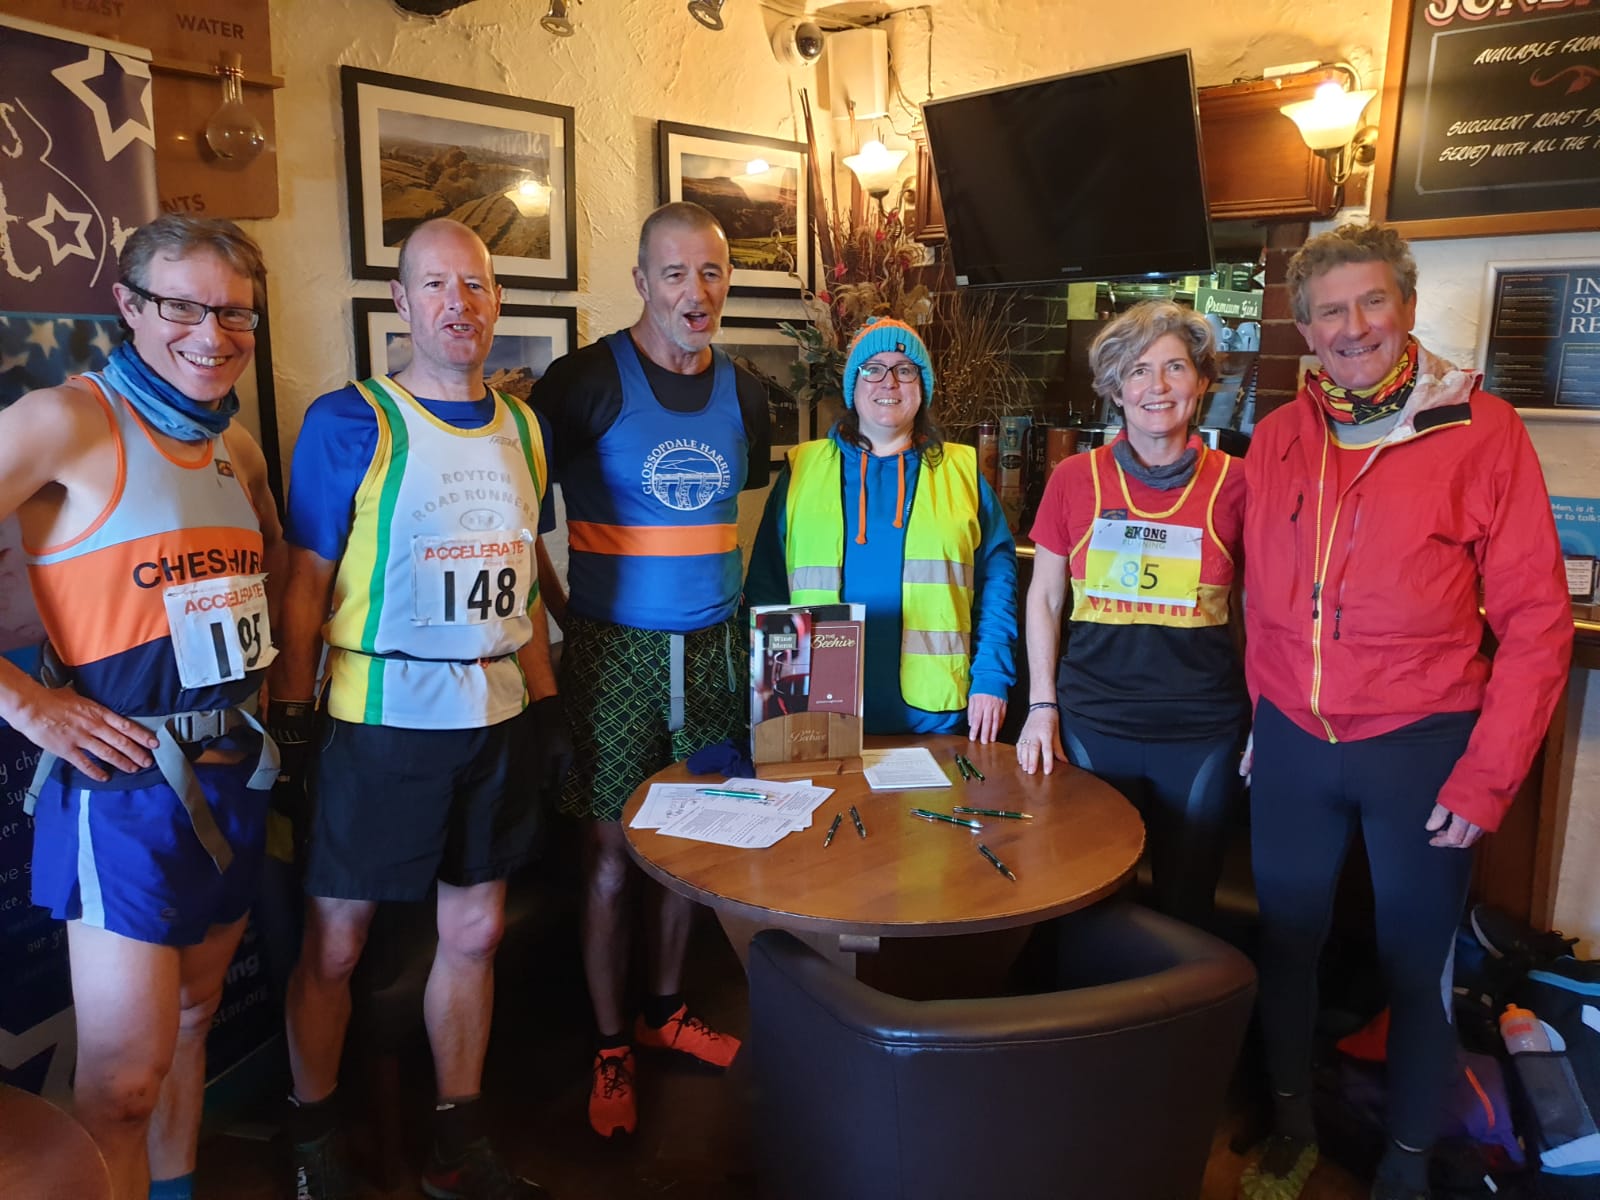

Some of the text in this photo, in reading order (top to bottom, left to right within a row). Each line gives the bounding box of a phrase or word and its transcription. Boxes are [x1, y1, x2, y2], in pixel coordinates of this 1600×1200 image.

[176, 13, 245, 39] WATER
[1473, 40, 1560, 65] AVAILABLE
[1447, 113, 1534, 137] SUCCULENT
[1533, 108, 1588, 129] ROAST
[1438, 144, 1491, 167] SERVED
[1491, 141, 1530, 158] WITH
[1528, 138, 1557, 154] ALL
[1559, 135, 1592, 151] THE
[1205, 295, 1240, 315] Premium
[1571, 297, 1600, 314] SP
[1568, 316, 1600, 334] RE
[441, 469, 512, 485] ROYTON
[641, 438, 731, 495] GLOSSOPDALE HARRIERS
[412, 492, 459, 522] ROAD
[1565, 513, 1576, 521] to
[1576, 504, 1585, 513] is
[1586, 503, 1595, 514] it
[1131, 526, 1168, 541] KONG
[423, 539, 525, 561] ACCELERATE
[1120, 560, 1160, 590] 85
[184, 583, 264, 615] ACCELERATE
[444, 567, 517, 623] 148
[209, 612, 262, 680] 195
[811, 634, 856, 649] Beehive
